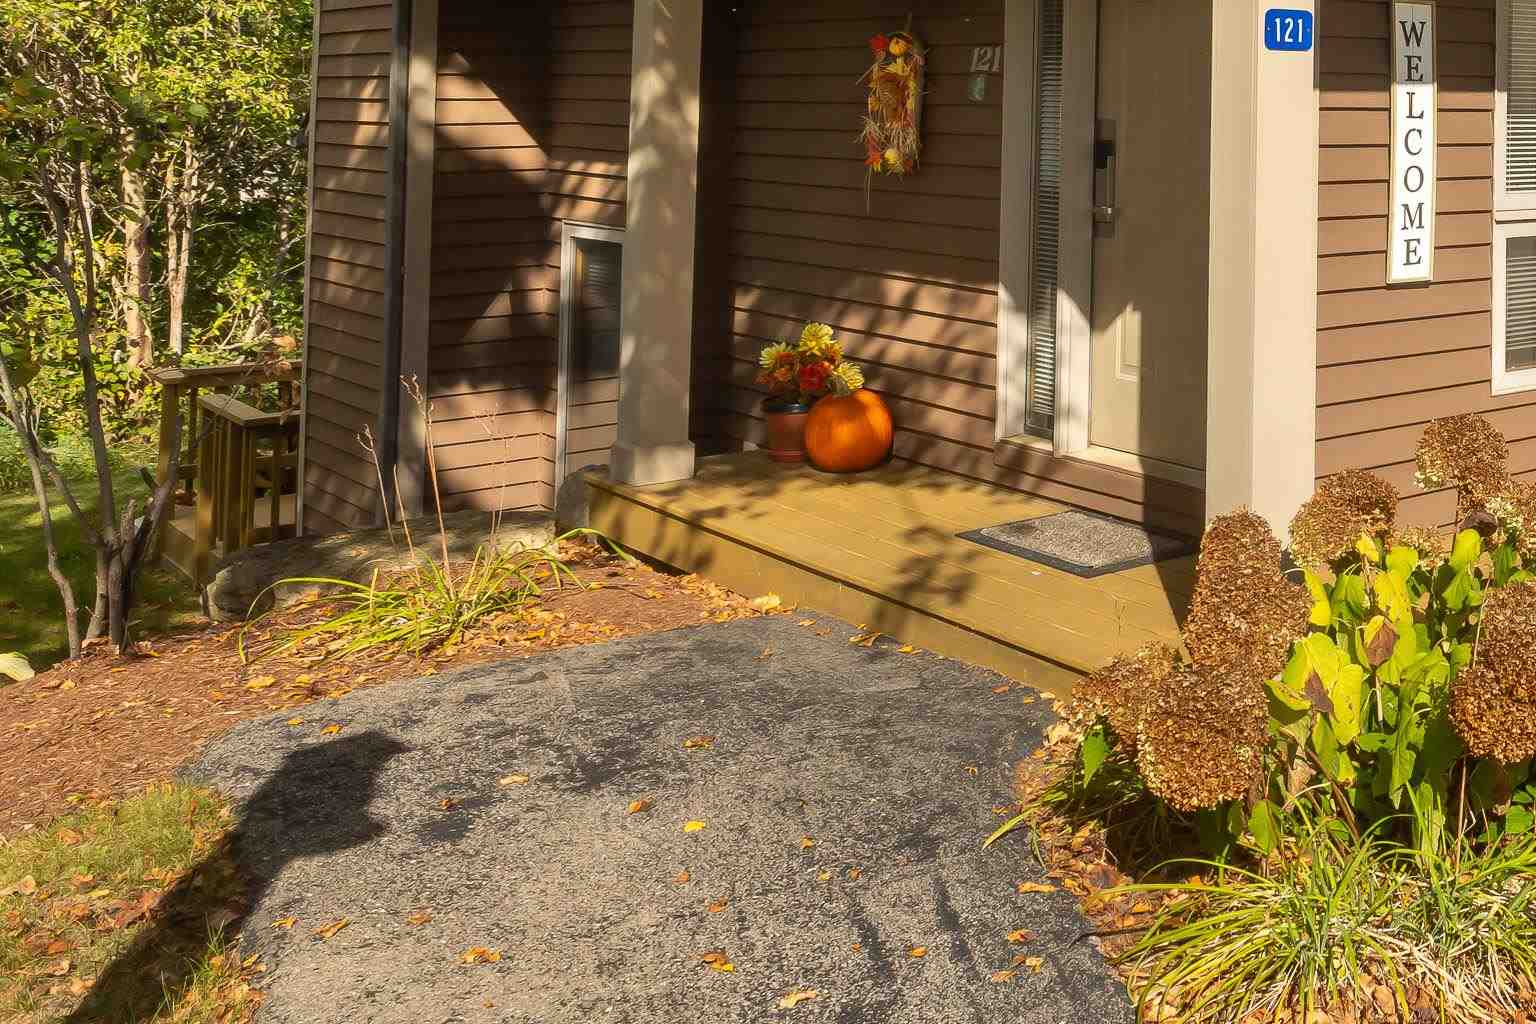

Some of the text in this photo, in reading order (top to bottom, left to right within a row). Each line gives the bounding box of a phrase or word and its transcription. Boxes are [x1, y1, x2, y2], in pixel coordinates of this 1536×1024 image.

[1274, 17, 1303, 43] 121
[970, 47, 1001, 73] 121
[1399, 20, 1427, 266] WELCOME
